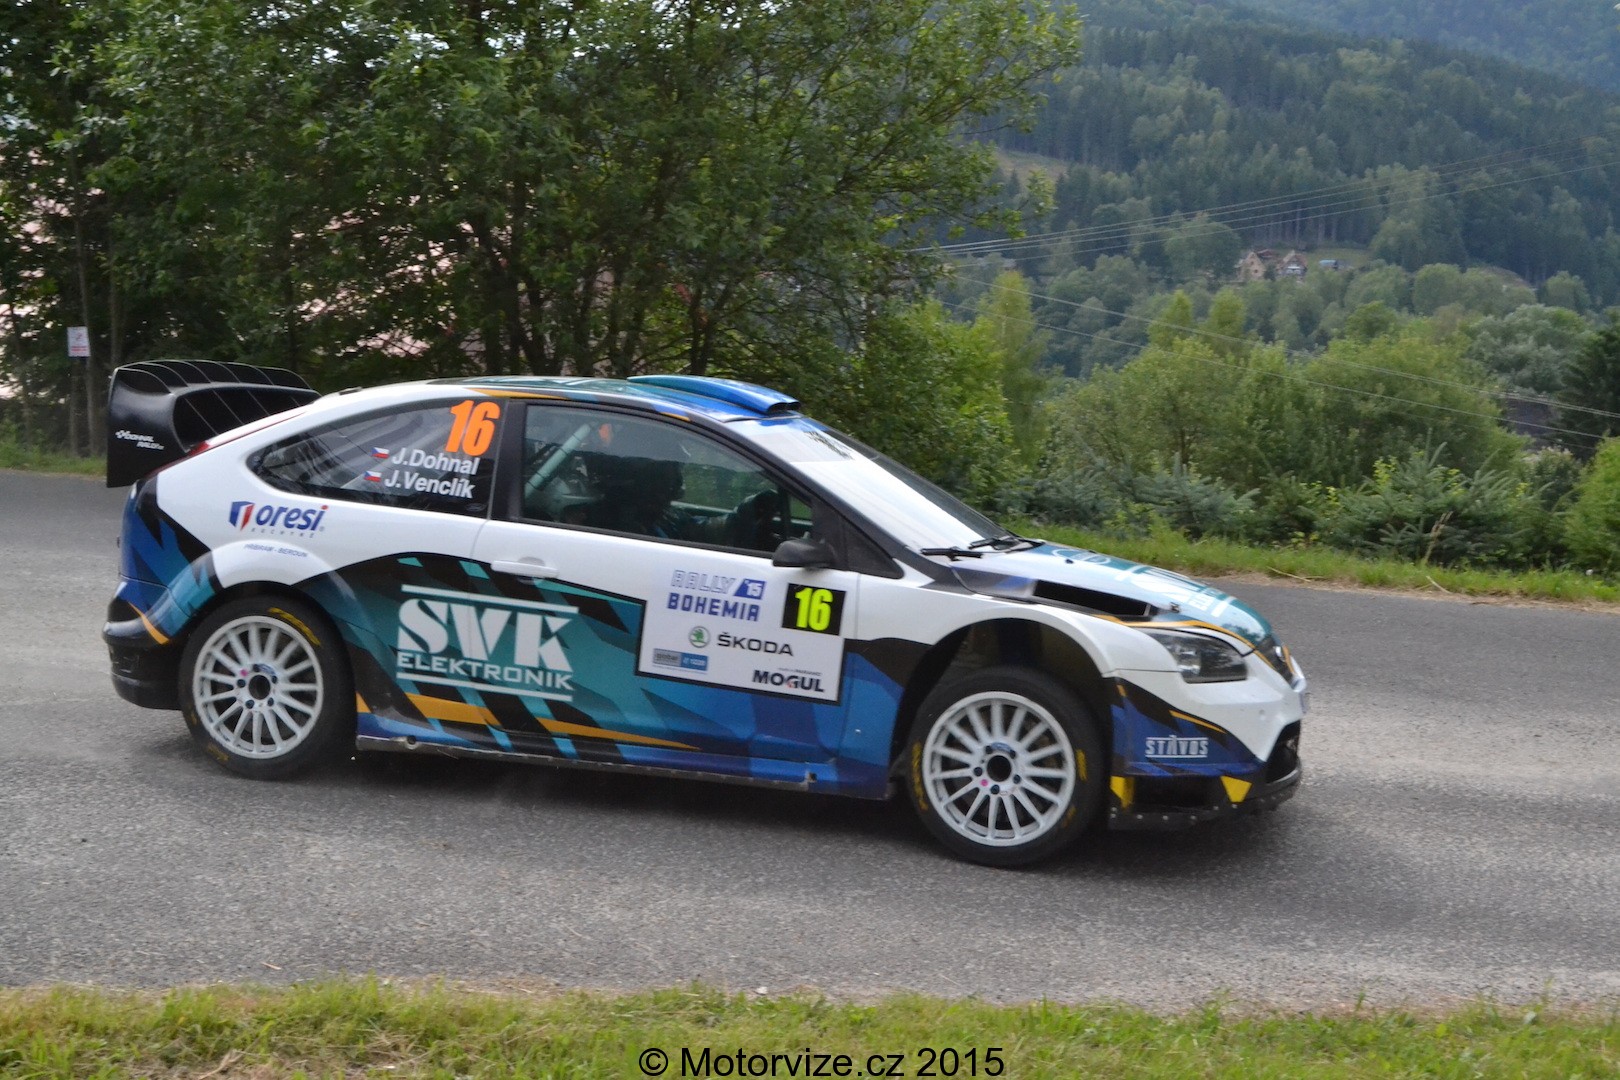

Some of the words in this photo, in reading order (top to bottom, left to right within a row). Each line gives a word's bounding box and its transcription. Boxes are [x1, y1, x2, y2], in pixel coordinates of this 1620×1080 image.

[446, 400, 500, 457] 16
[392, 447, 480, 476] J.Dohnal
[255, 504, 329, 532] oresi
[671, 569, 736, 595] RALLY
[667, 592, 760, 622] BOHEMIA
[795, 587, 834, 632] 16
[398, 598, 573, 673] SVK
[717, 631, 794, 657] ŠKODA
[397, 651, 575, 690] ELEKTRONIK
[752, 669, 825, 693] MOGUL
